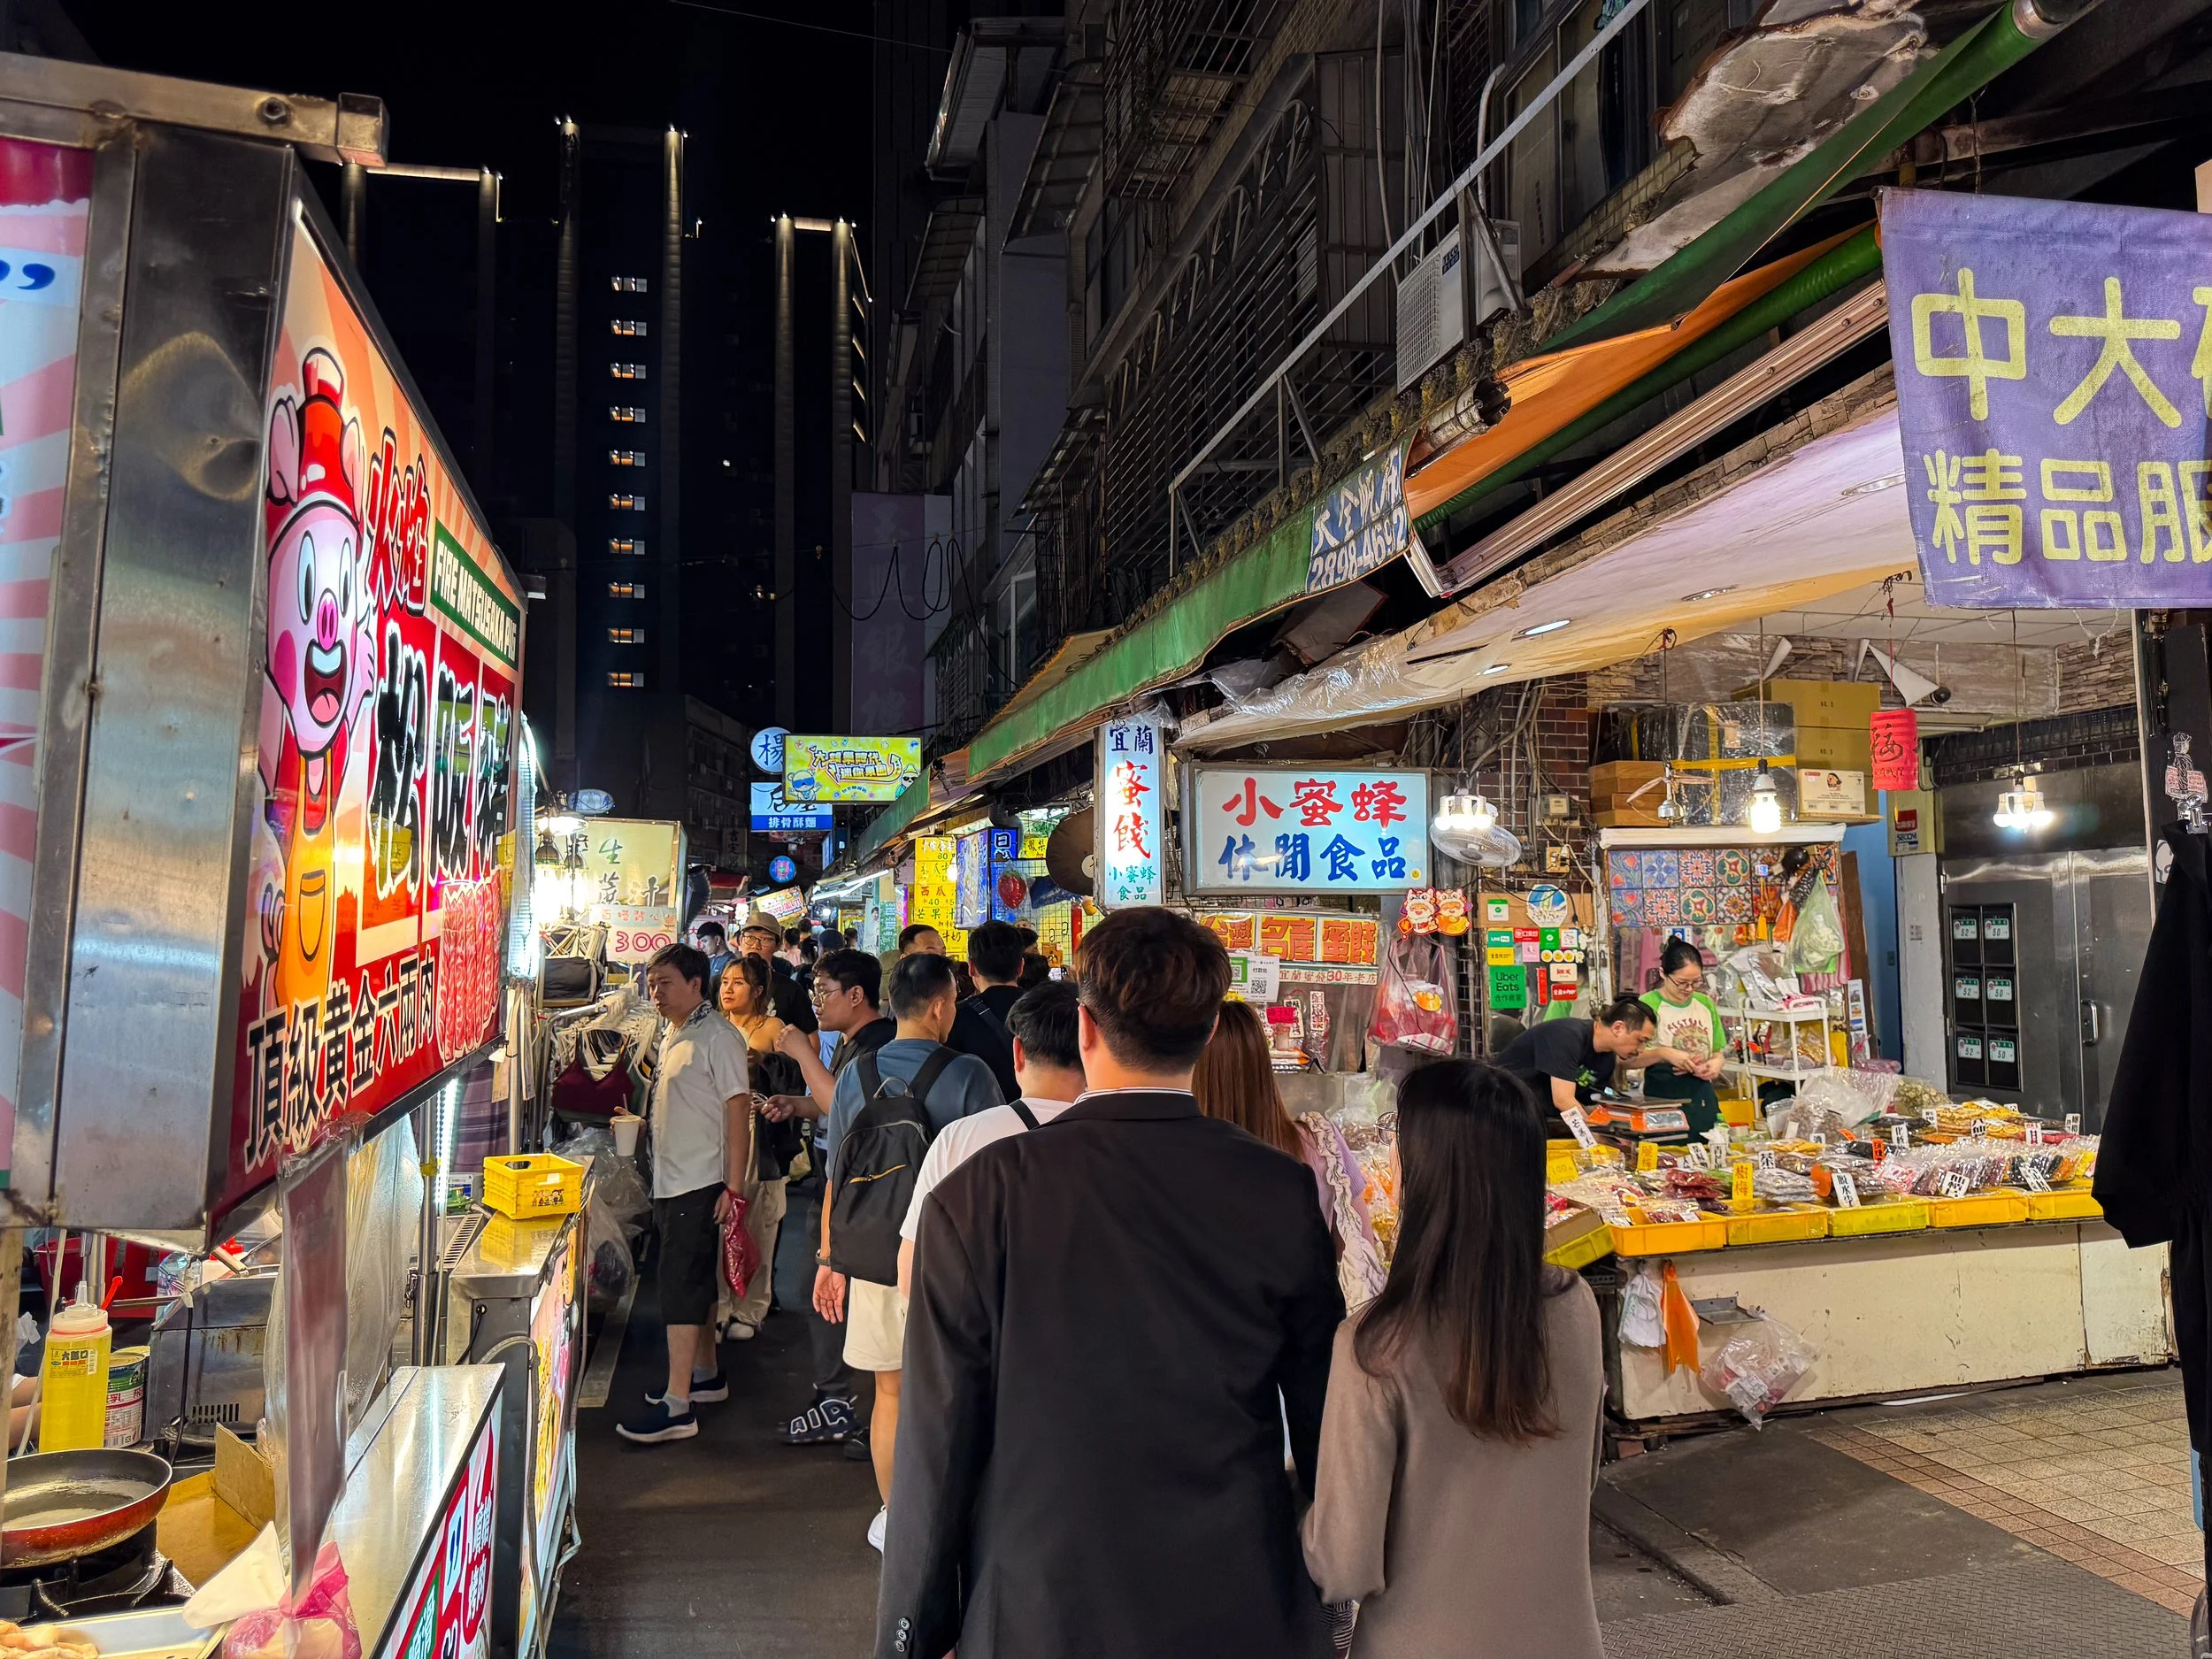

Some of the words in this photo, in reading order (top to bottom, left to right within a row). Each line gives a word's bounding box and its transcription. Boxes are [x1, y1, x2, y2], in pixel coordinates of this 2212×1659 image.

[1443, 243, 1459, 264] TECO
[1310, 507, 1406, 592] 2898-4692
[434, 539, 458, 608] FIRE
[457, 565, 505, 653] MATSUSAKA
[503, 616, 517, 662] PIG
[1109, 726, 1154, 755] 宜蘭
[1114, 760, 1151, 859] 蜜餞
[1222, 777, 1407, 827] 小蜜蜂
[1218, 833, 1407, 882] 休閒食品
[1108, 865, 1157, 885] 小蜜蜂
[1117, 885, 1148, 901] 食品
[616, 932, 672, 953] 300
[1495, 972, 1518, 981] Uber
[1496, 982, 1520, 992] Eats
[790, 1399, 855, 1435] AIR
